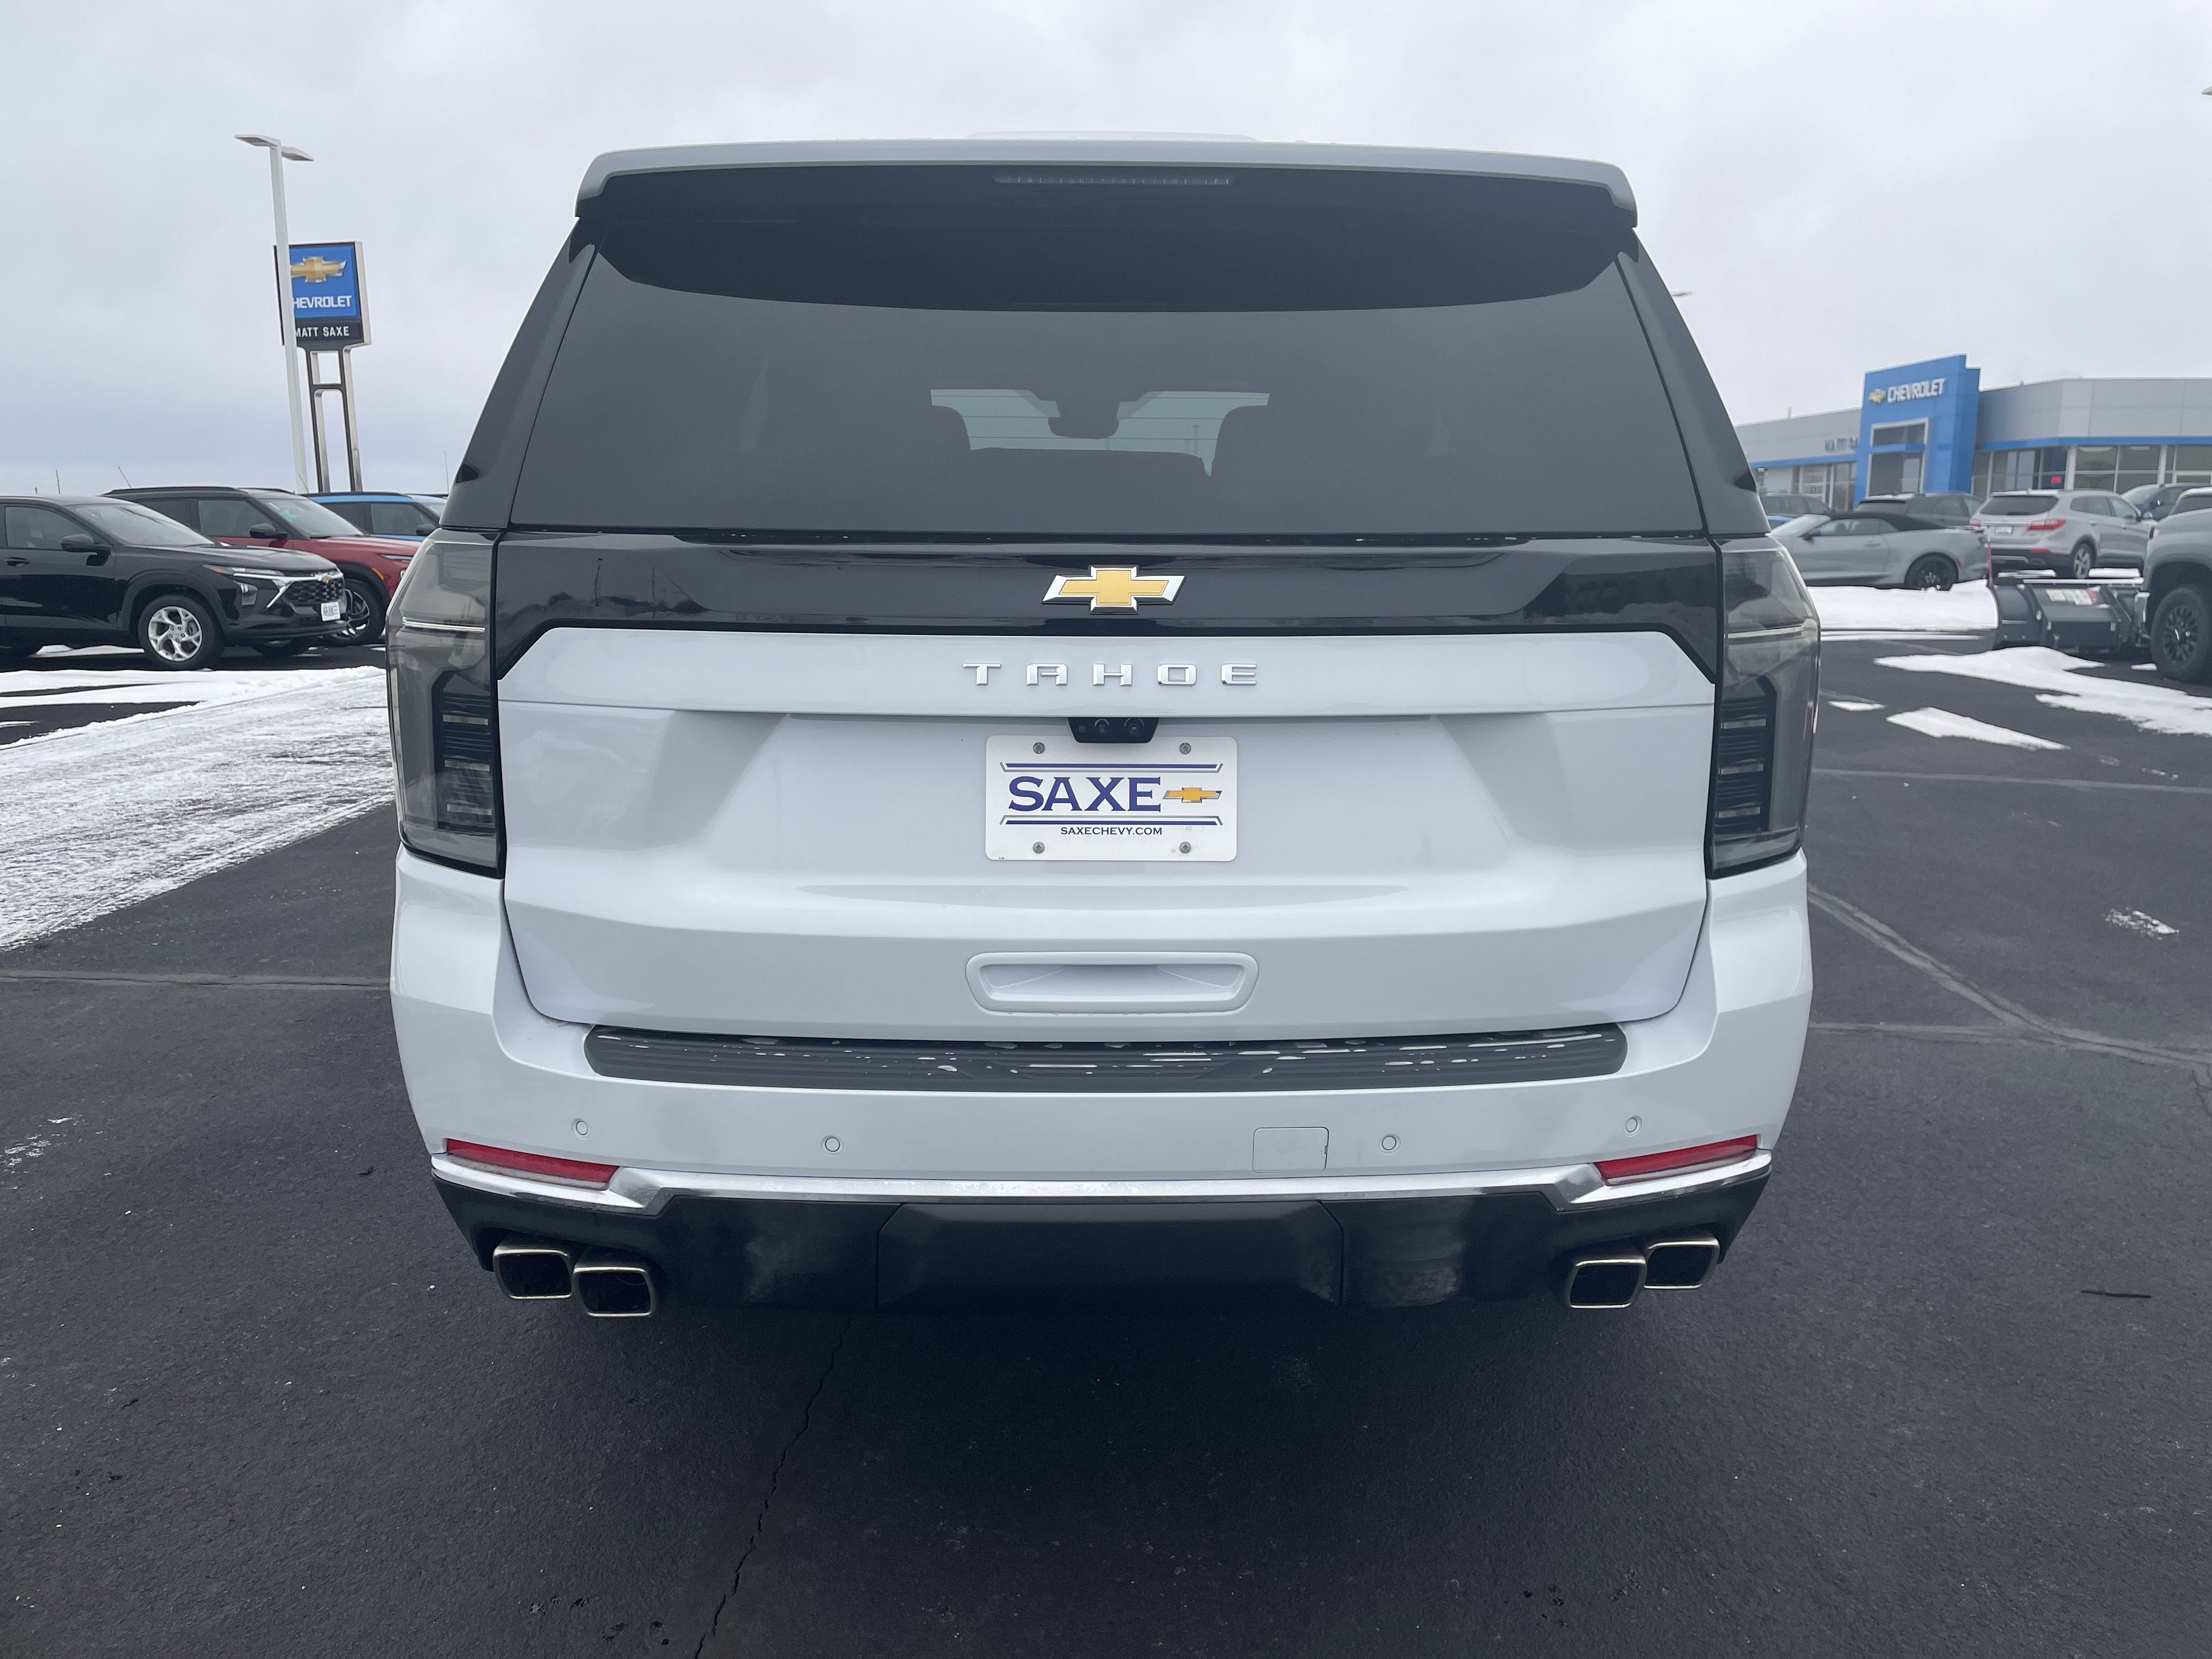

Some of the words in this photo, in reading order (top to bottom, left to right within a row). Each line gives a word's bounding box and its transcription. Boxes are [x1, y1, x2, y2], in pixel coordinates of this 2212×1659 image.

[293, 295, 352, 309] HEVROLET
[323, 326, 350, 337] SAXE
[1887, 377, 1945, 403] CHEVROLET
[962, 663, 1257, 686] TAHOE
[1008, 776, 1161, 813] SAXE
[1060, 827, 1163, 836] SAXECHEVY.COM
